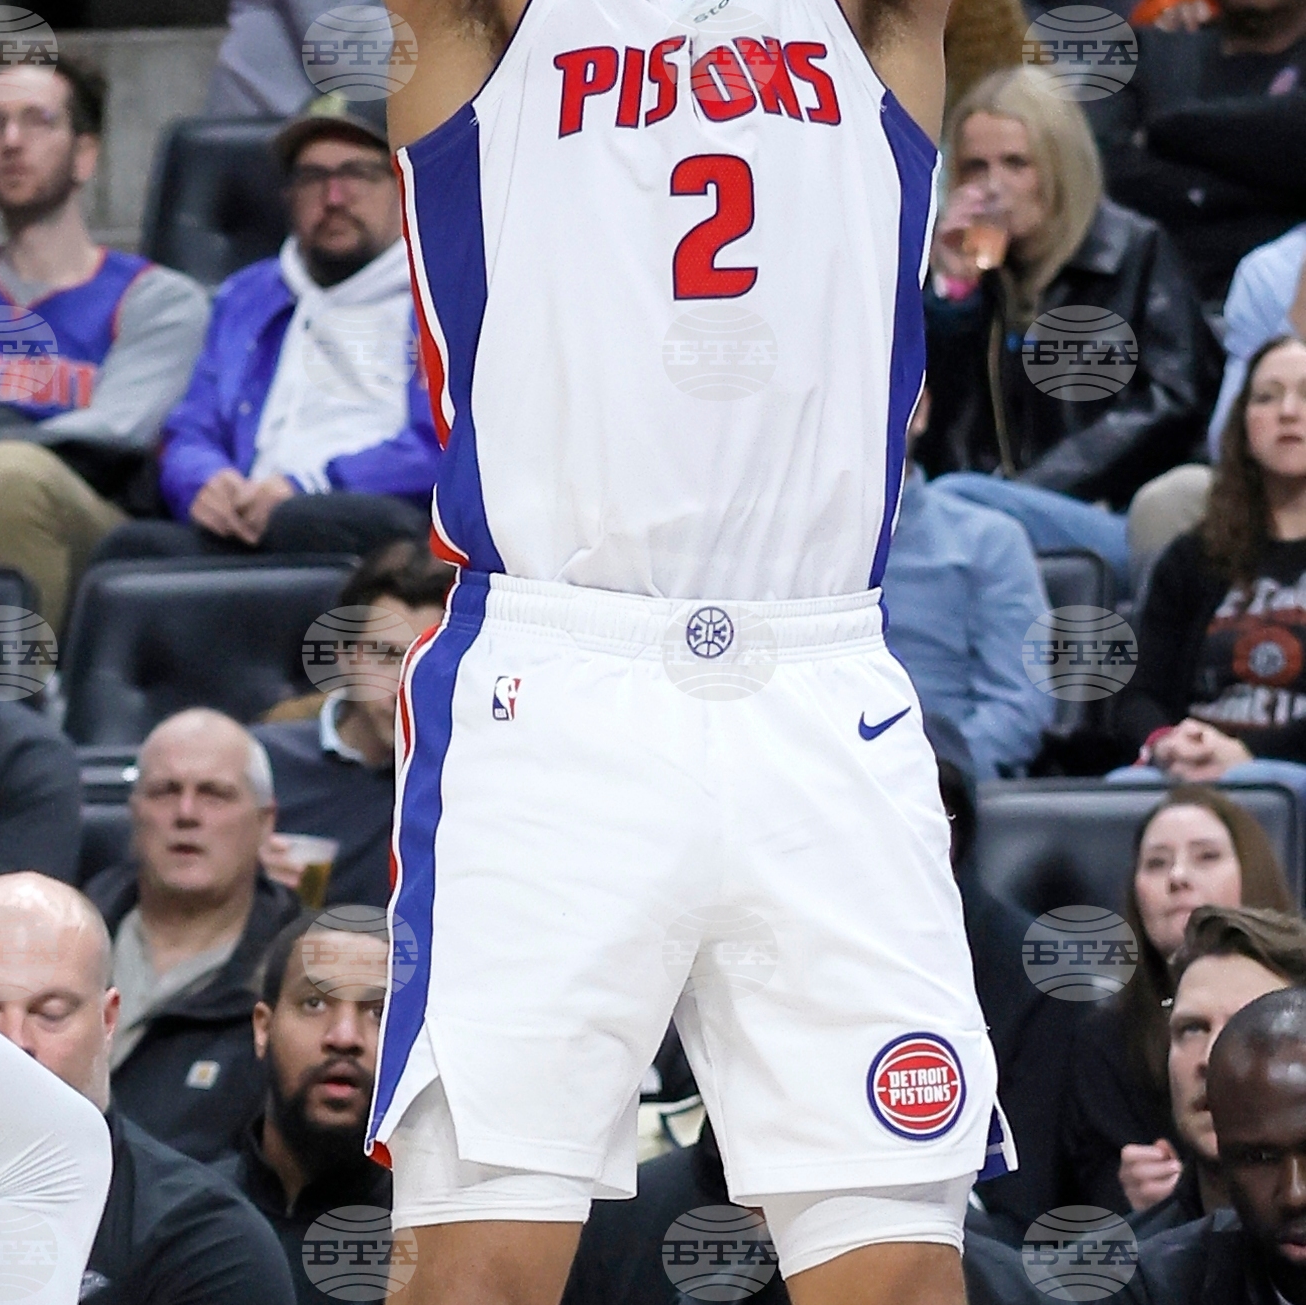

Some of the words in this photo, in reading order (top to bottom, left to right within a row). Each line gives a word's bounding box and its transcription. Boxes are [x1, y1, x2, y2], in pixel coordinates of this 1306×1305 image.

[553, 35, 842, 139] PISONS
[670, 153, 758, 301] 2
[887, 1066, 949, 1088] DETROIT
[888, 1084, 951, 1106] PISTONS
